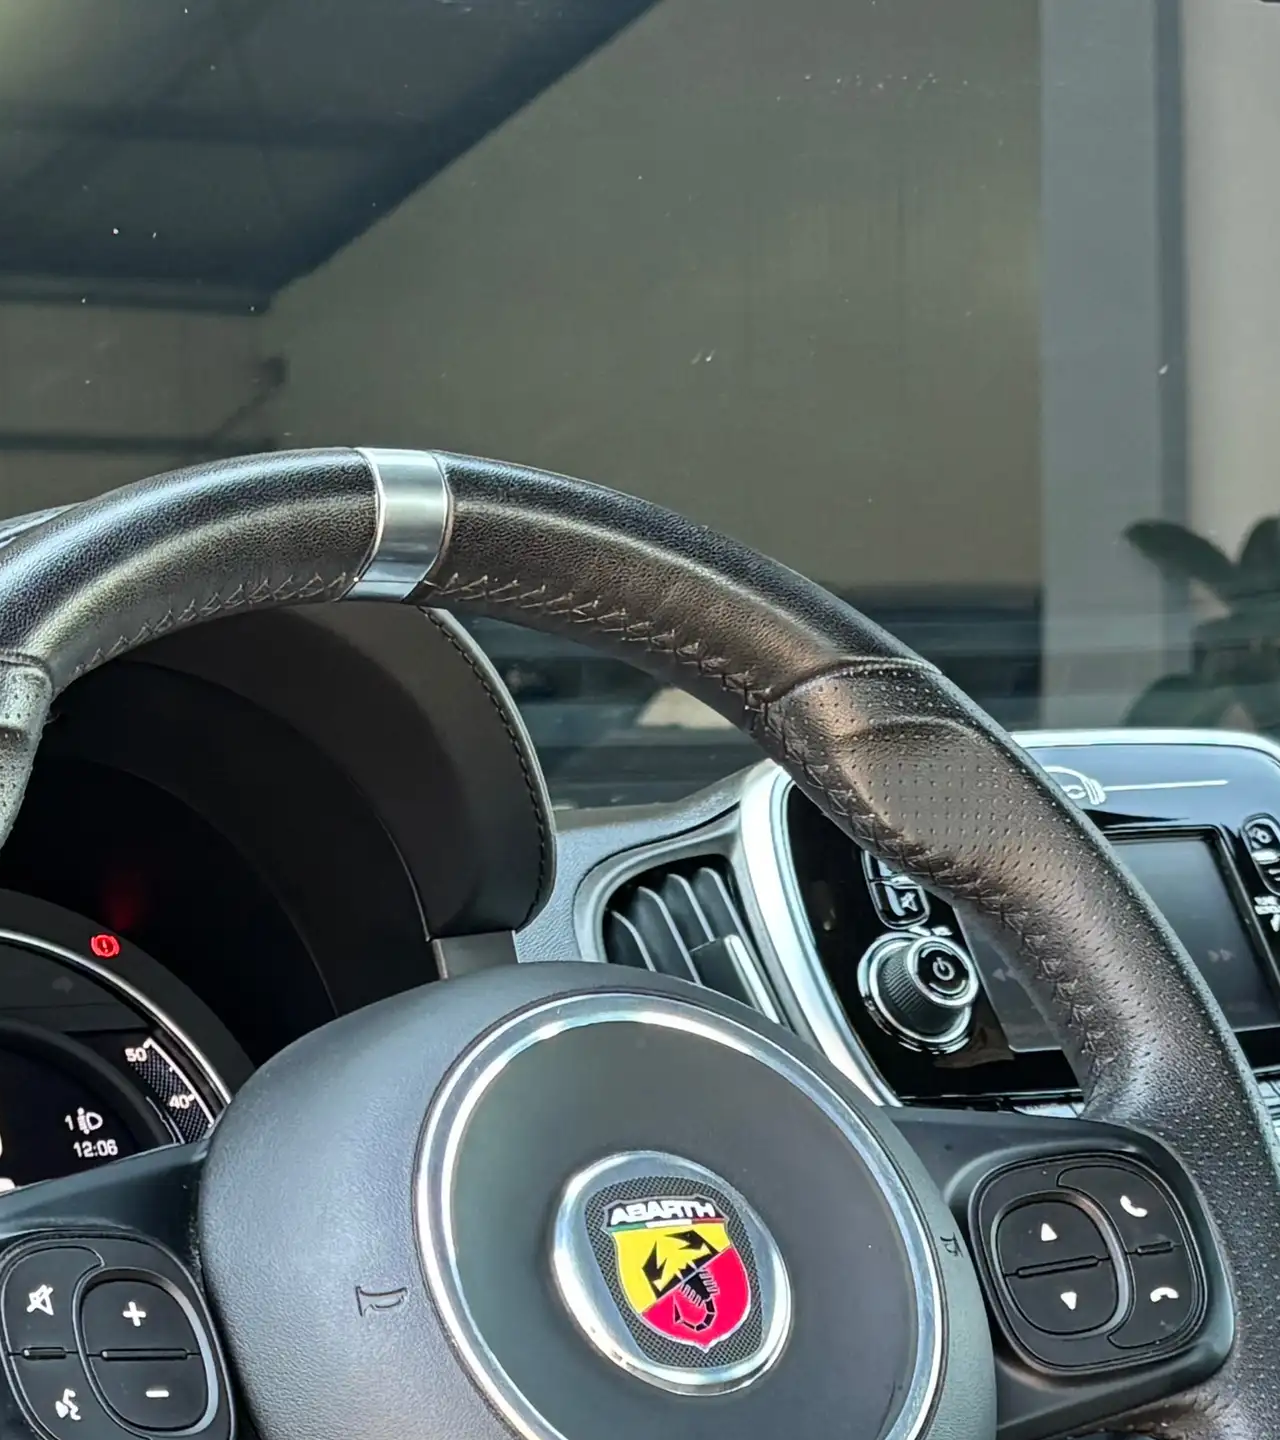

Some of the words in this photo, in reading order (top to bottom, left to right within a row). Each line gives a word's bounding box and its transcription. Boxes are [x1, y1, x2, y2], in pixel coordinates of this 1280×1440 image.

[125, 1046, 148, 1063] 50
[168, 1093, 191, 1110] 40
[73, 1140, 119, 1158] 12:06
[610, 1199, 716, 1226] ABARTH
